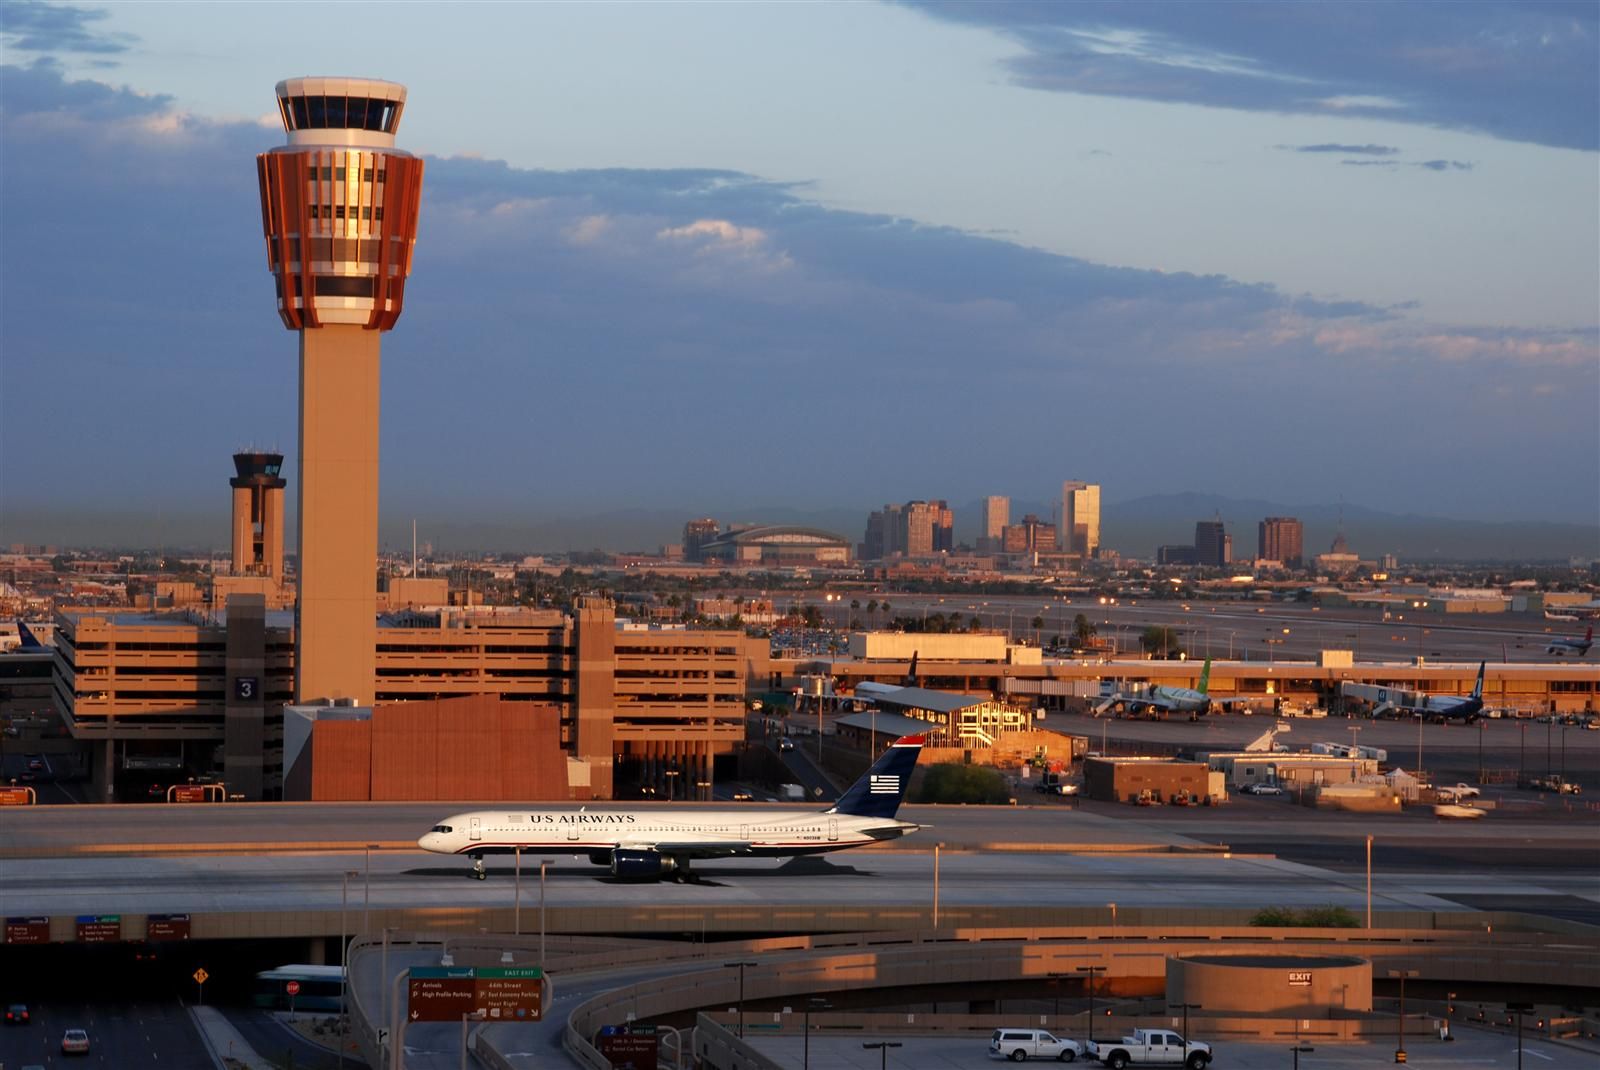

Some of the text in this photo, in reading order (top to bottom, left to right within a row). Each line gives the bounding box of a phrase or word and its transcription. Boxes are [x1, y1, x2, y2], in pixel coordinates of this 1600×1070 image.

[241, 682, 252, 698] 3
[558, 815, 636, 823] AIRWAYS
[467, 967, 474, 977] 4
[1289, 973, 1312, 981] EXIT
[623, 1026, 629, 1035] 3
